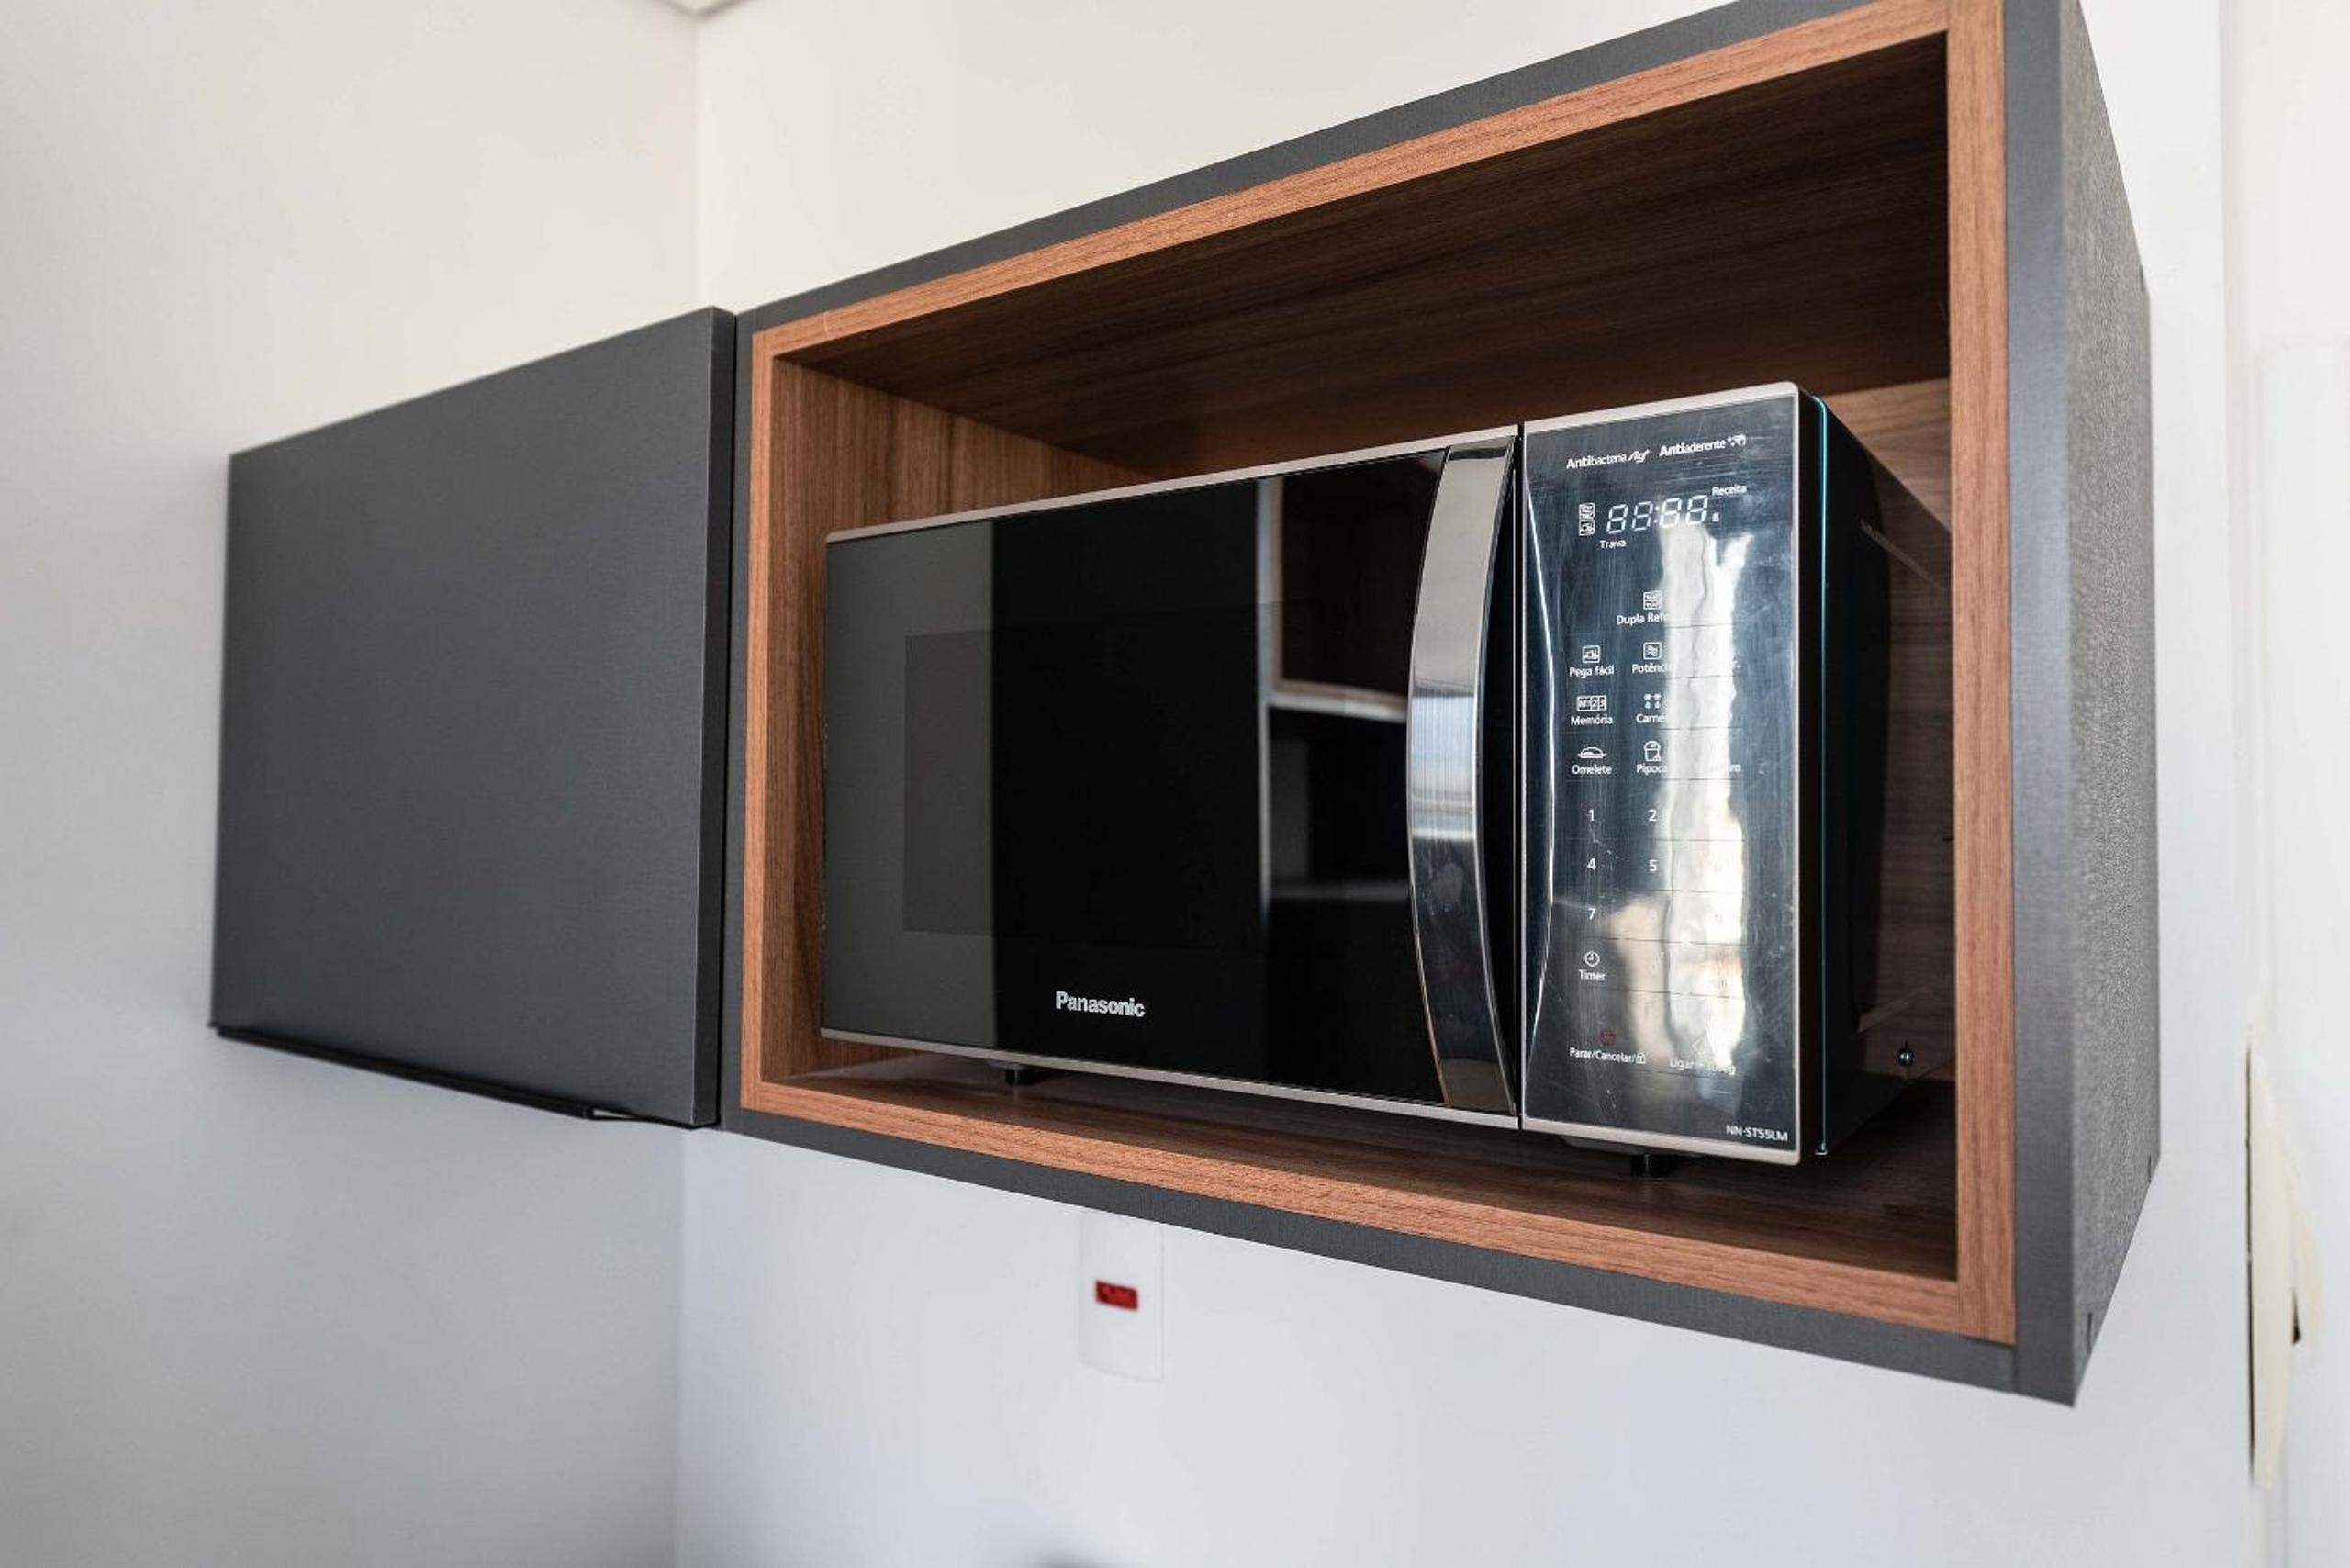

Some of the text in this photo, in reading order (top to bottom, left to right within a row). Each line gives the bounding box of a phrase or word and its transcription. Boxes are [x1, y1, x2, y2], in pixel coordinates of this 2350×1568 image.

[1659, 439, 1727, 457] Antiaderente
[1566, 453, 1627, 469] Antibacteria
[1711, 485, 1748, 497] Receita
[1599, 539, 1628, 549] Trava
[1616, 613, 1645, 626] Dupla
[1569, 663, 1615, 679] Pega fácil
[1571, 713, 1614, 725] Memória
[1572, 764, 1613, 775] Omelete
[1636, 764, 1668, 775] Pipoca
[1587, 809, 1595, 822] 1
[1648, 809, 1658, 822] 2
[1586, 857, 1597, 871] 4
[1649, 859, 1659, 872] 5
[1587, 907, 1596, 921] 7
[1578, 969, 1606, 981] Timer
[1056, 991, 1146, 1017] Panasonic
